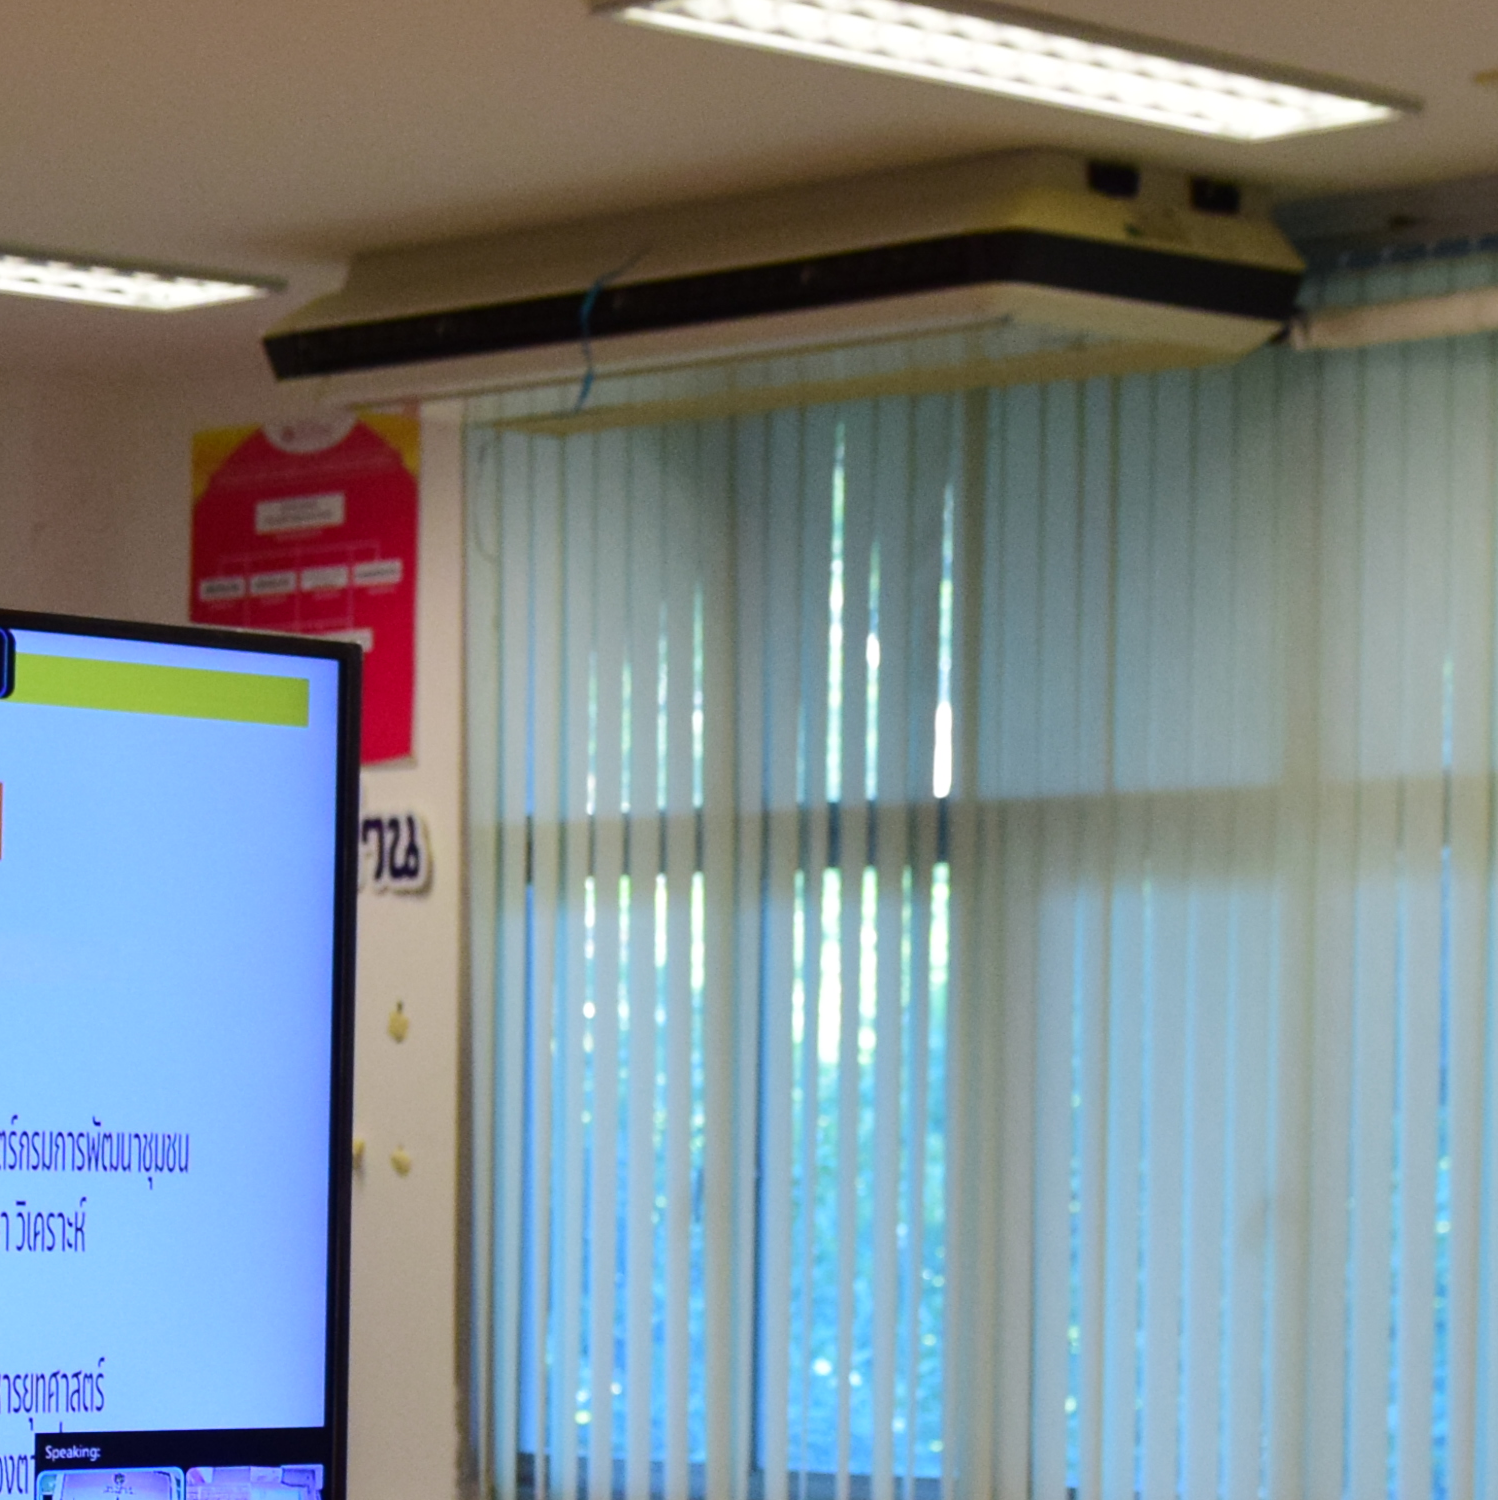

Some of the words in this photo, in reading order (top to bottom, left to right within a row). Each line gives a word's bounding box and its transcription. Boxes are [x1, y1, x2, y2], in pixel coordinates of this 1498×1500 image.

[361, 814, 420, 880] าน
[15, 1196, 88, 1253] วิเคราะห์
[44, 1444, 101, 1463] Speaking:
